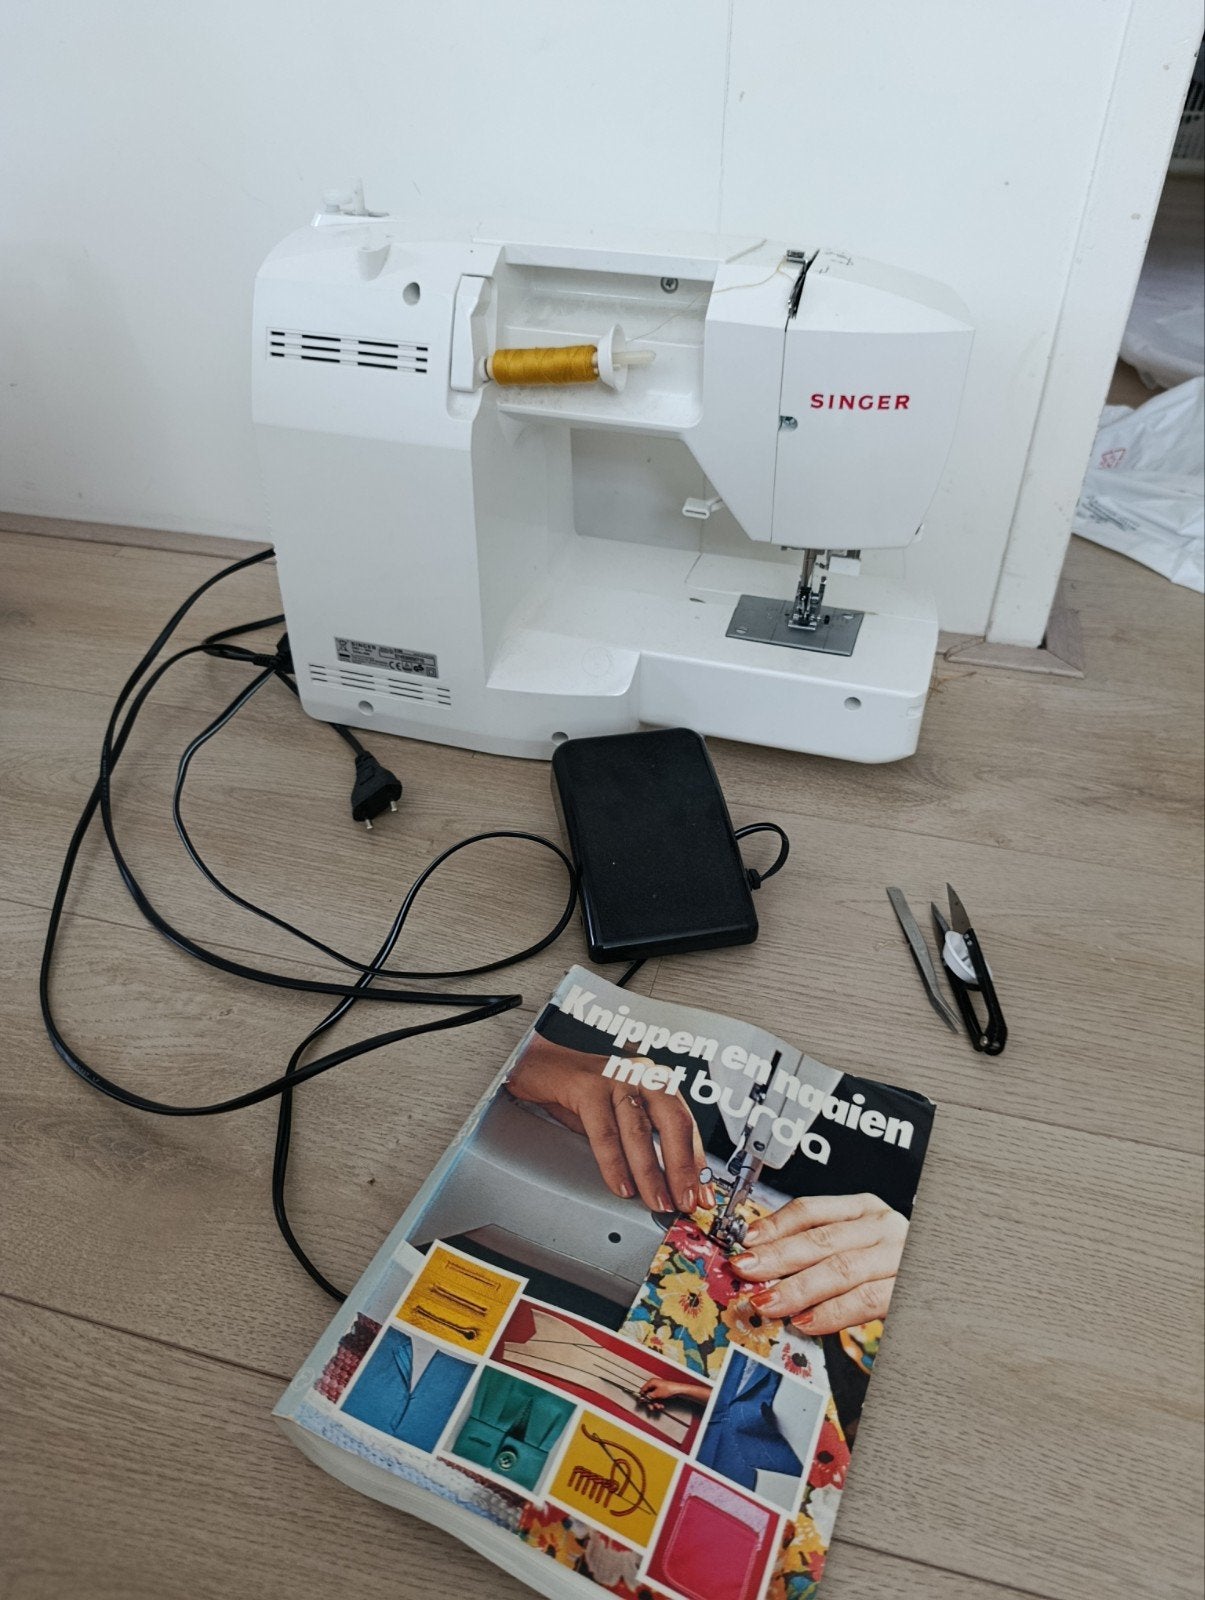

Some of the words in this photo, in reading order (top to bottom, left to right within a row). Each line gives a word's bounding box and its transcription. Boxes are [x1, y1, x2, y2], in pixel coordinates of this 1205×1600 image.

[810, 393, 910, 410] SINGER
[559, 984, 719, 1061] Knippen
[721, 1045, 777, 1084] en
[773, 1068, 915, 1150] naaien
[601, 1055, 687, 1096] met
